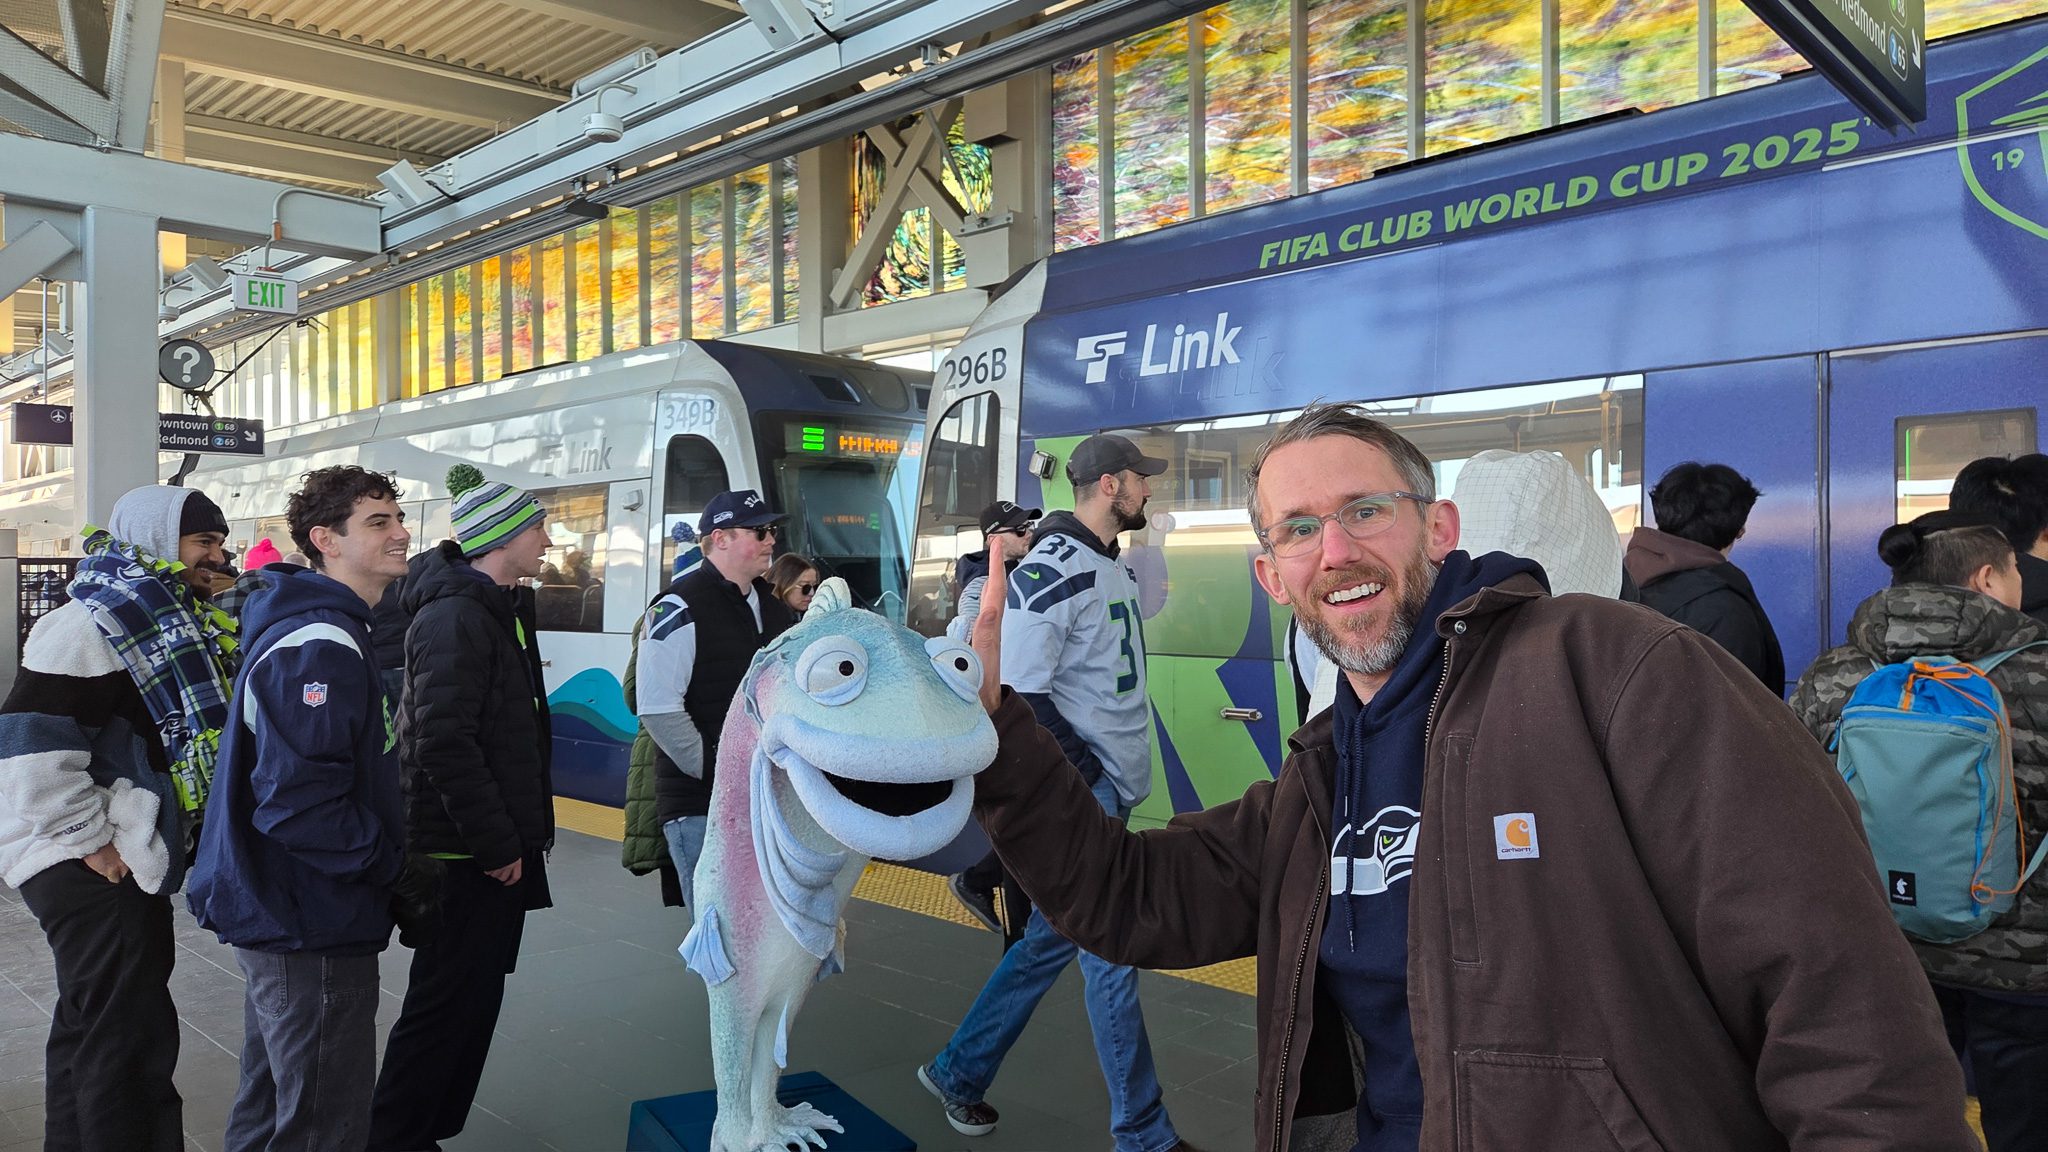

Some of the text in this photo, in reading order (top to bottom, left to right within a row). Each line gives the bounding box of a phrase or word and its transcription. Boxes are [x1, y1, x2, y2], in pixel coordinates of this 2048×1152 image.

[1991, 149, 2024, 171] 19
[1259, 231, 1329, 269] FIFA
[1338, 209, 1432, 253] CLUB
[1444, 175, 1599, 233] WORLD
[1609, 152, 1708, 198] CUP
[248, 280, 286, 309] EXIT
[1139, 312, 1242, 377] Link
[944, 347, 1007, 391] 296B
[225, 423, 235, 431] 68
[664, 399, 715, 432] 349B
[225, 438, 235, 447] 65
[568, 437, 613, 475] Link
[1038, 535, 1078, 563] 31
[307, 692, 324, 703] NFL
